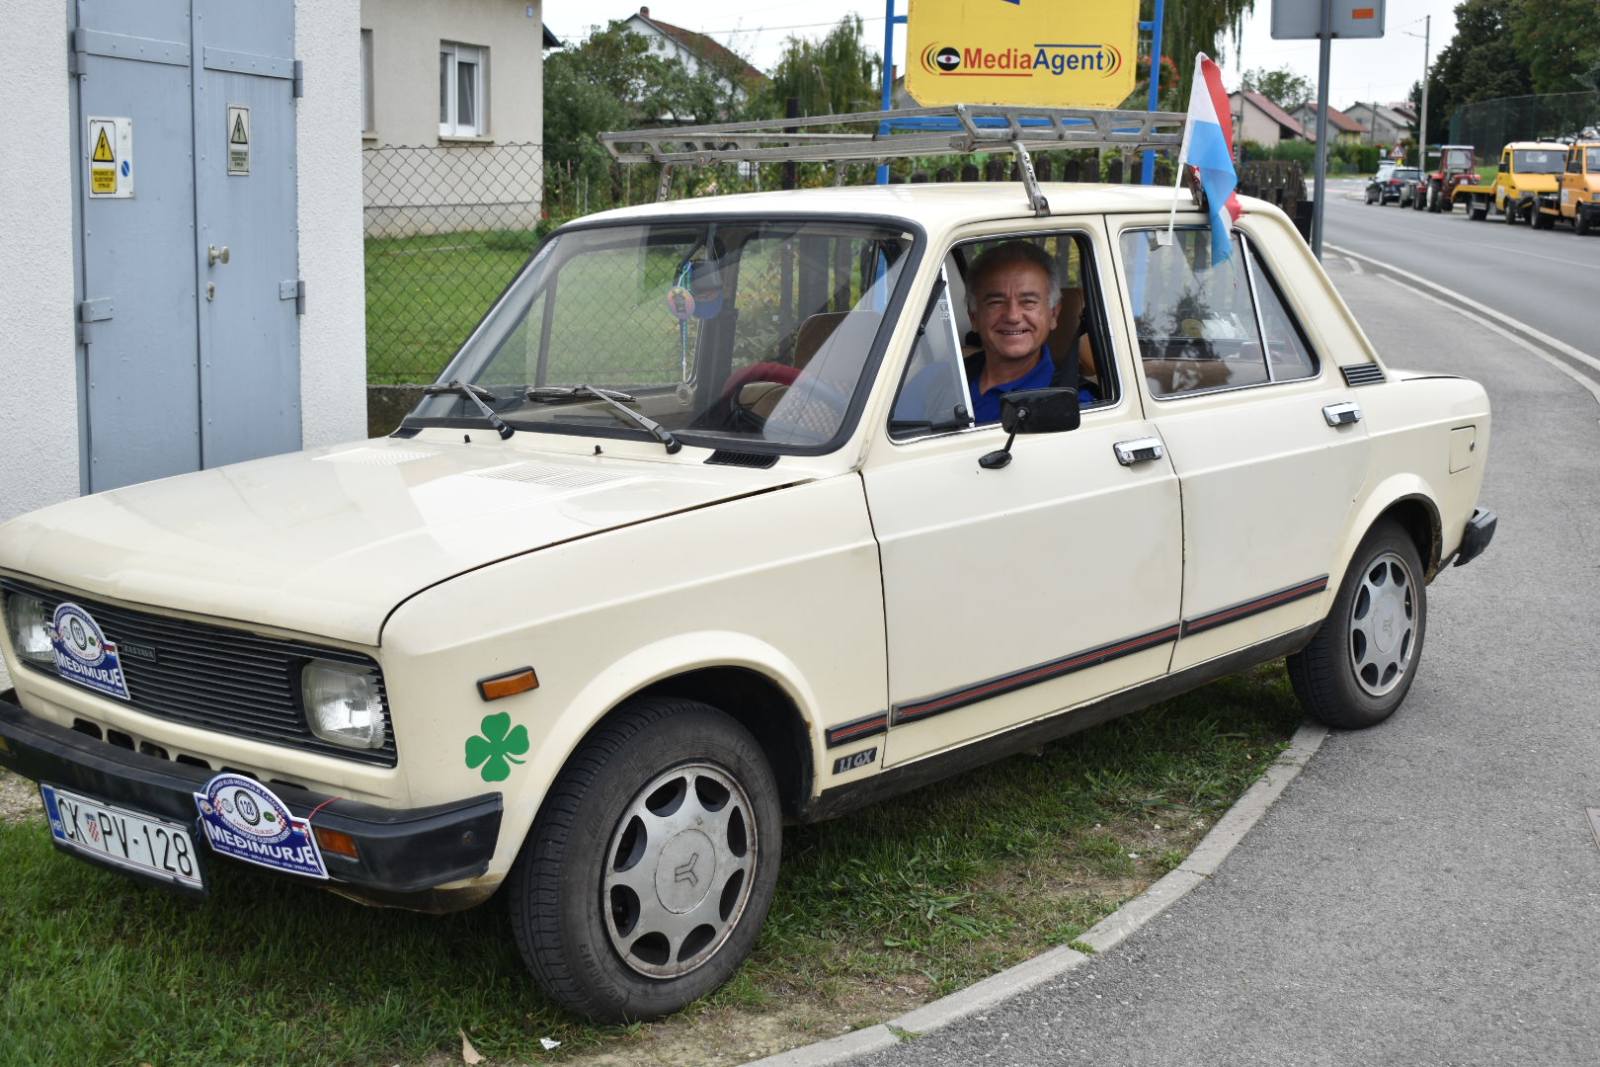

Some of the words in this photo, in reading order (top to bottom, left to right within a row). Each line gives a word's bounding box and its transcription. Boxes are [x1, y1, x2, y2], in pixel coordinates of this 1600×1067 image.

[963, 47, 1104, 76] MediaAgent
[239, 800, 256, 818] 128
[58, 798, 88, 845] CK
[98, 811, 193, 877] PV-128
[206, 820, 319, 868] MEĐIMURJE
